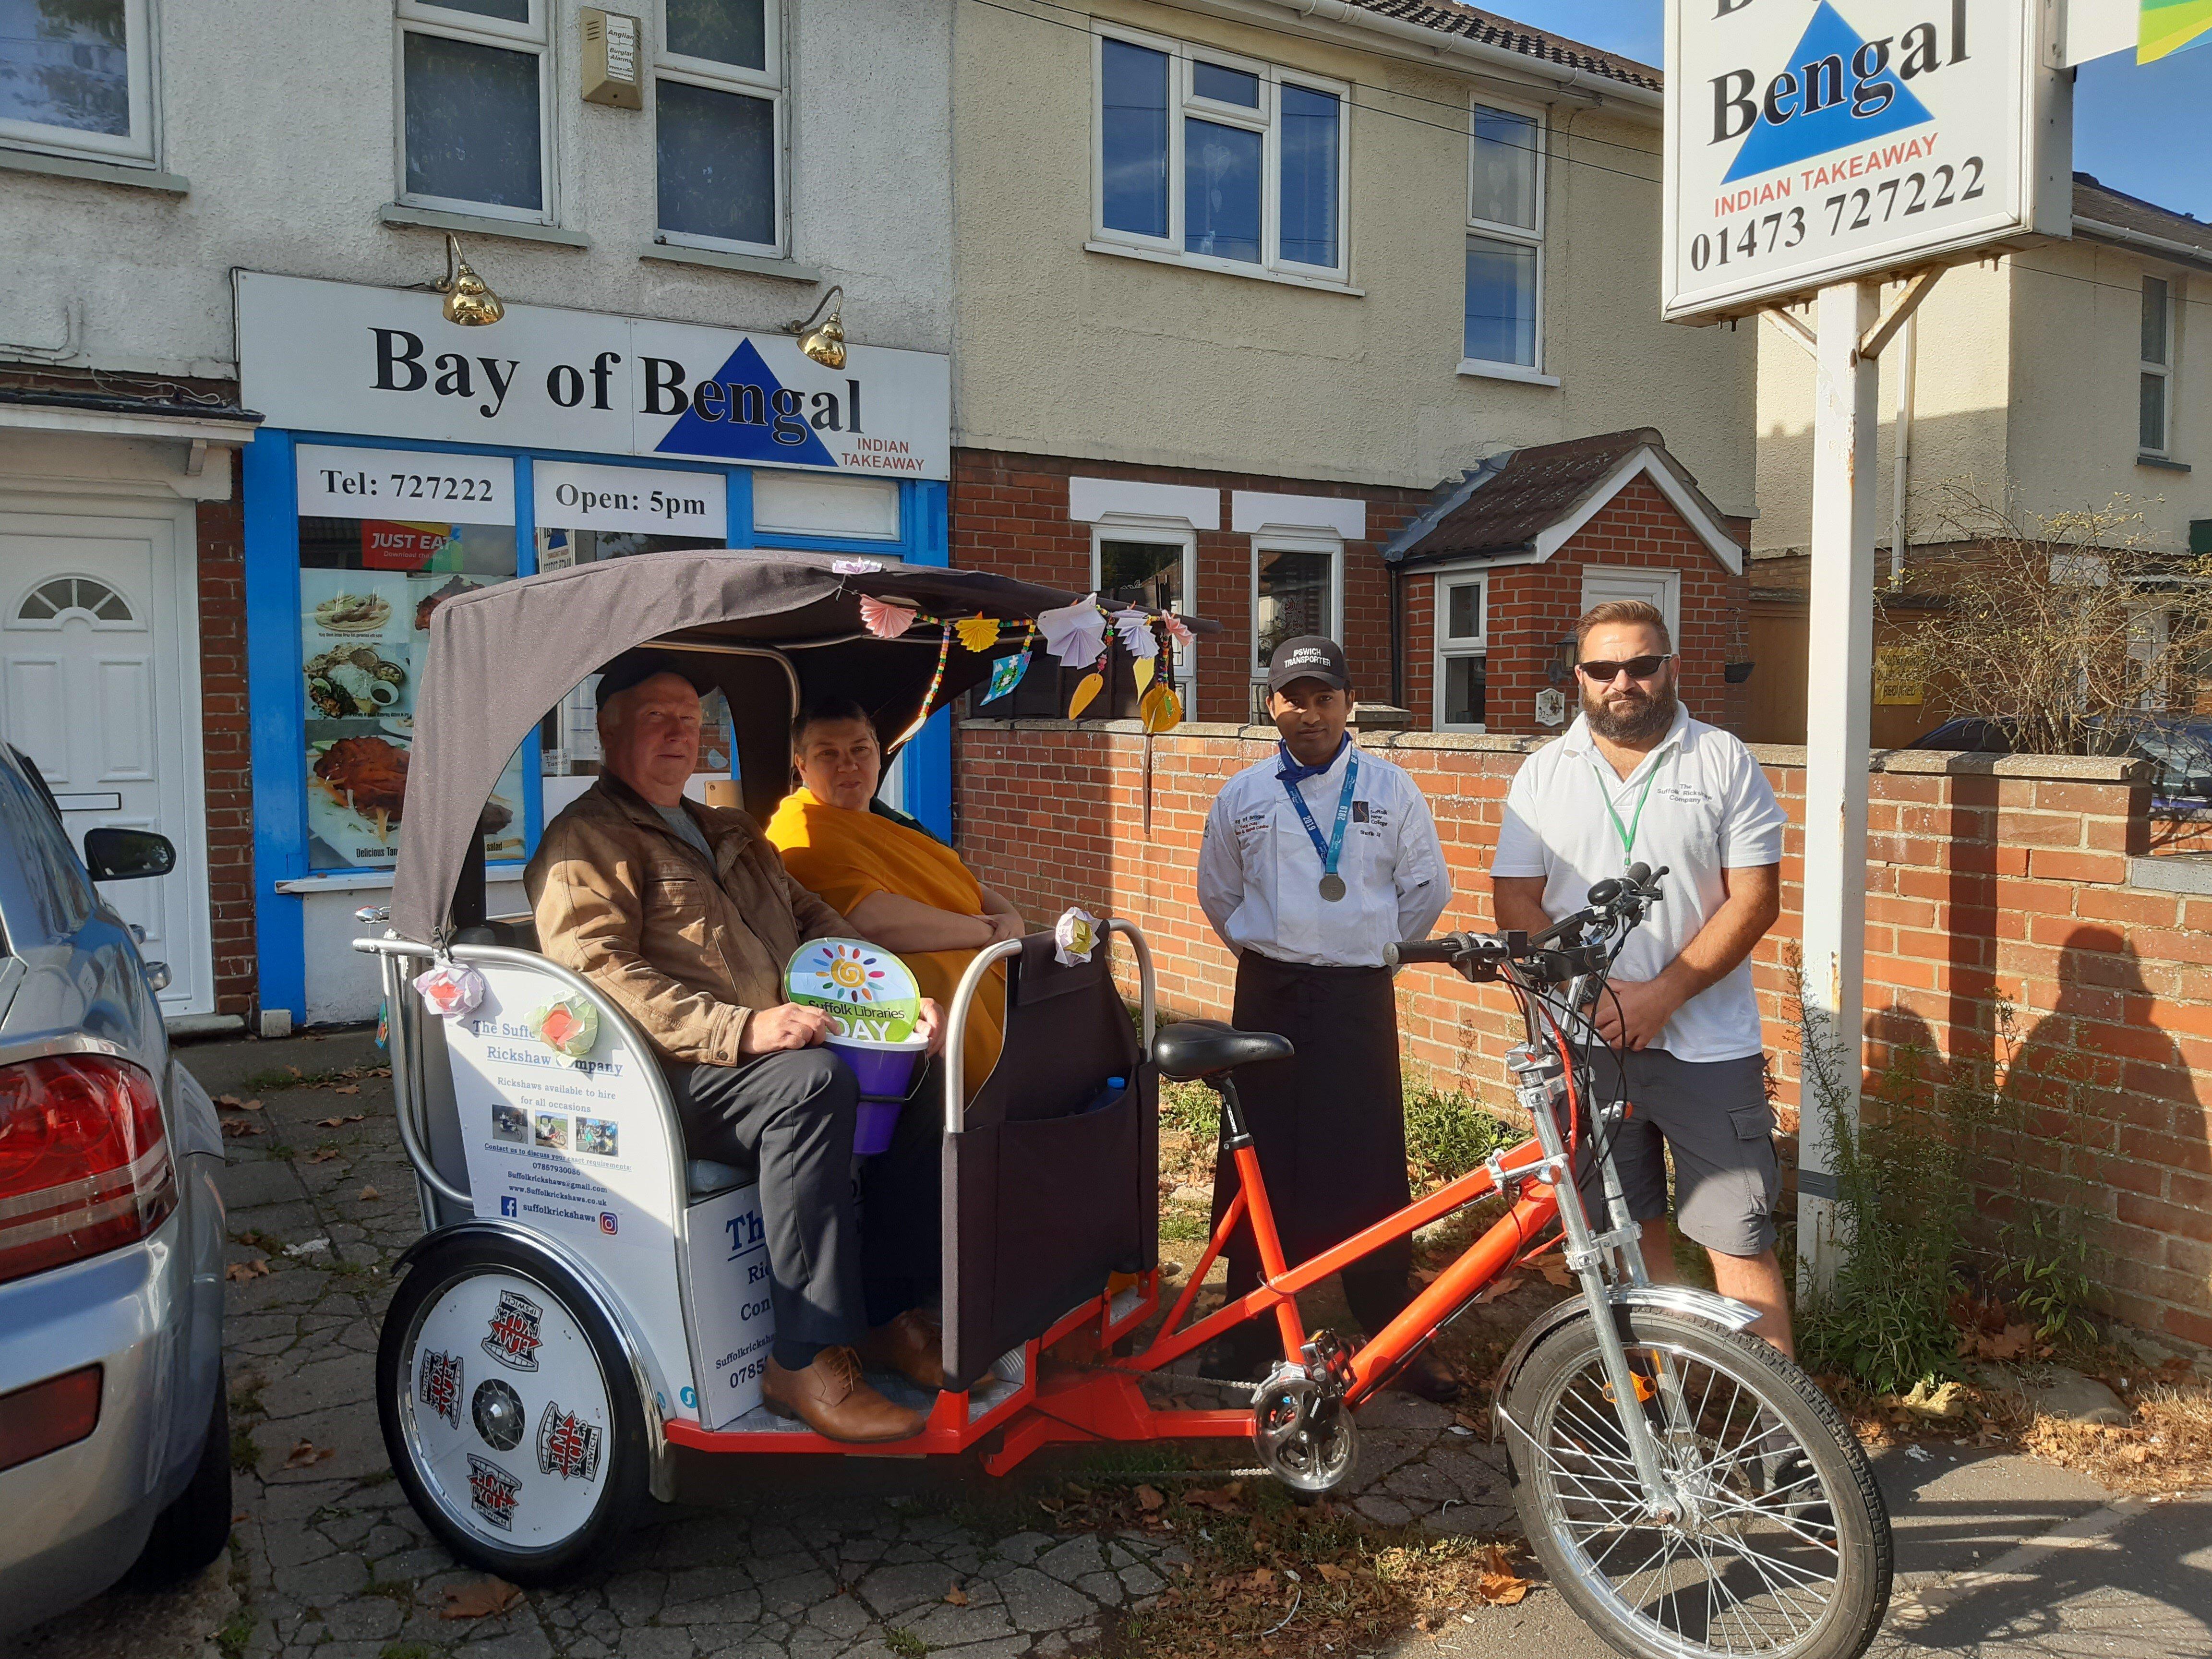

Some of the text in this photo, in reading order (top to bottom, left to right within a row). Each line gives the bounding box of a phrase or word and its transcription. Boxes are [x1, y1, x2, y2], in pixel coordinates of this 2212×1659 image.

[608, 29, 634, 39] Anglian
[609, 47, 633, 56] Burglar
[610, 54, 632, 63] Alarms
[1707, 0, 1972, 146] Bengal
[1714, 132, 1939, 218] INDIAN TAKEAWAY
[1691, 155, 1986, 272] 01473 727222
[367, 327, 864, 445] Bay of Bengal
[857, 437, 909, 454] INDIAN
[841, 452, 925, 471] TAKEAWAY
[320, 469, 493, 502] Tel: 727222
[555, 483, 707, 519] Open: 5pm
[371, 532, 453, 551] JUST EAT
[1284, 656, 1331, 668] TRANSPORTER
[1293, 648, 1321, 657] IPSWICH
[1669, 794, 1701, 804] Company
[1683, 790, 1713, 800] Rickshaw
[1303, 815, 1316, 831] 2019
[1337, 805, 1348, 821] 2019
[356, 848, 385, 858] Delicious
[486, 842, 503, 852] salad
[854, 1005, 905, 1019] Libraries
[473, 1020, 497, 1034] The
[487, 1046, 623, 1076] Rickshaw mpany
[497, 1077, 616, 1100] Rickshaws available to hire
[521, 1095, 591, 1113] for all occasions
[484, 1143, 508, 1152] Contact
[527, 1149, 550, 1159] discuss
[552, 1154, 566, 1162] your
[523, 1203, 596, 1223] suffolkrickshaws
[725, 1210, 765, 1251] Th
[505, 1296, 537, 1316] IPSWICH
[493, 1306, 541, 1339] CYCLES
[493, 1327, 530, 1356] ELMY
[430, 1353, 444, 1412] CYCLES
[441, 1367, 454, 1411] ELMY
[552, 1419, 569, 1467] ELMY
[567, 1418, 588, 1478] CYCLES
[587, 1433, 597, 1475] IPSWICH
[477, 1470, 509, 1499] ELMY
[471, 1482, 514, 1518] CYCLES
[477, 1503, 506, 1526] IPSWICH
